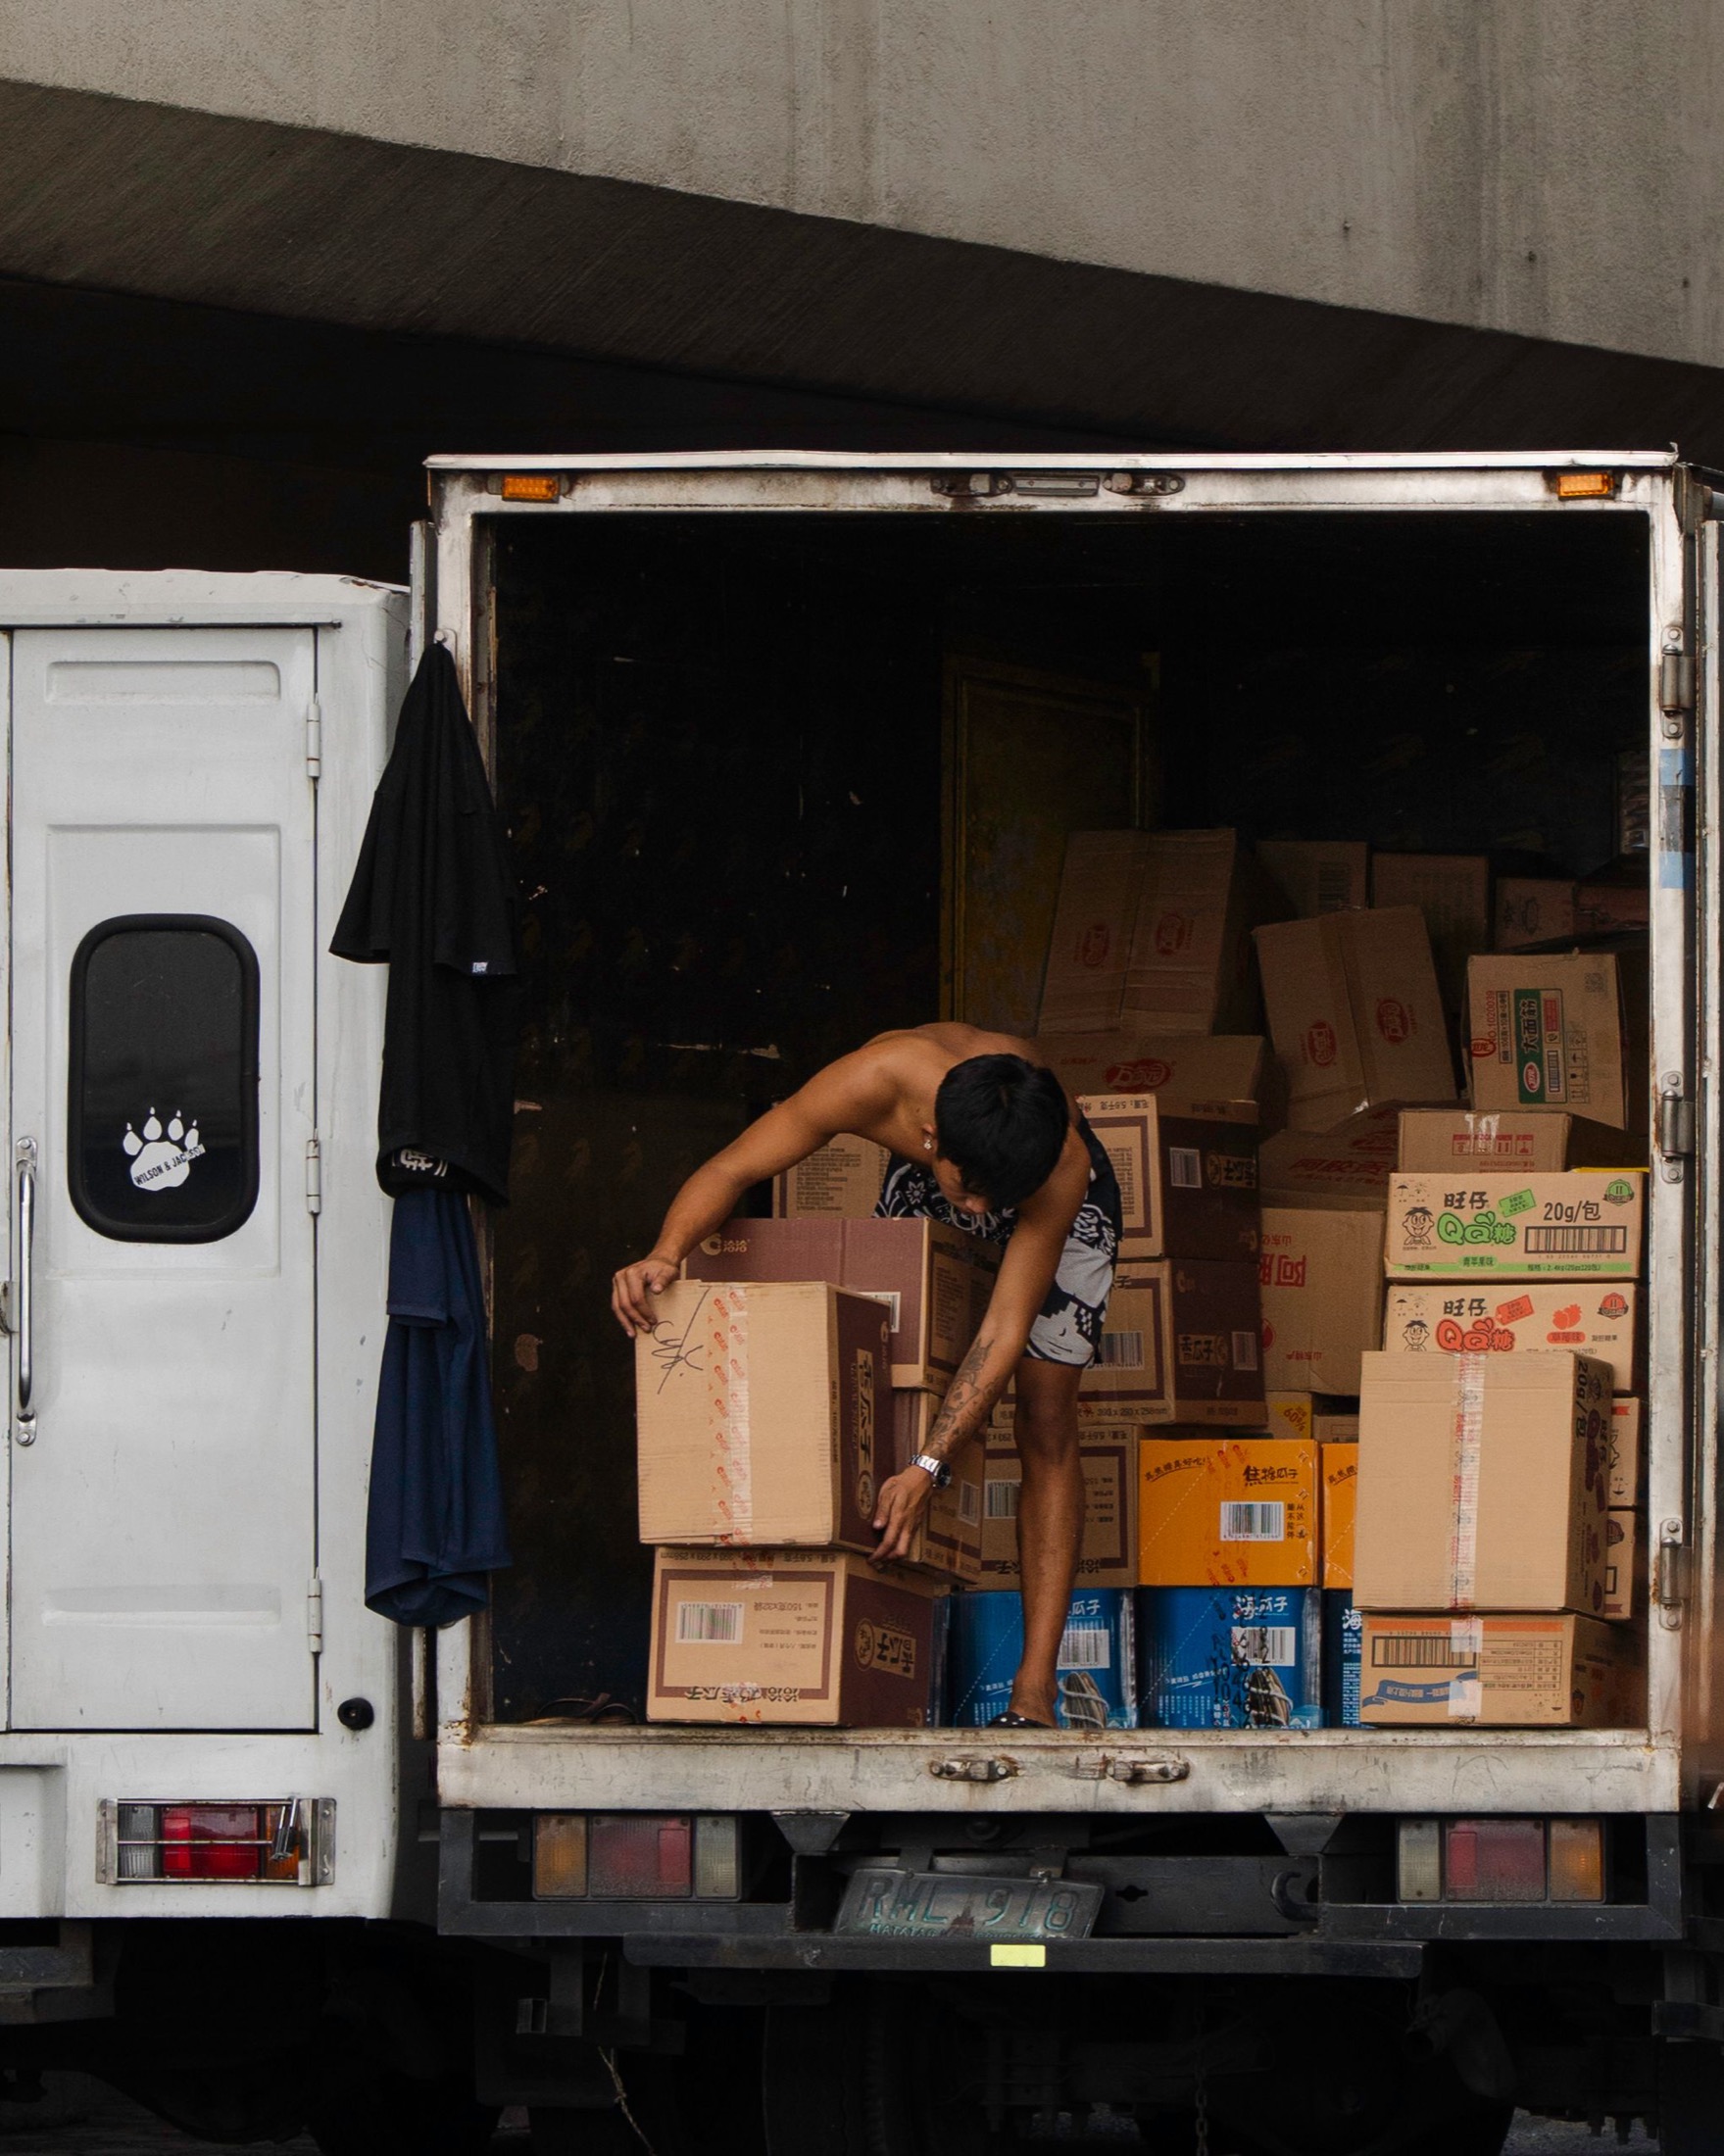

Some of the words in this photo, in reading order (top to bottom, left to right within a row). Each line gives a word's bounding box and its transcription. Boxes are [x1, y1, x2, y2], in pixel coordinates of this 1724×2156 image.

[1519, 999, 1539, 1054] 大面筋
[133, 1164, 164, 1185] WILSON
[163, 1161, 172, 1171] &
[172, 1145, 204, 1167] JACSO
[1444, 1191, 1489, 1209] 旺仔
[1544, 1200, 1601, 1223] 20g/包
[1437, 1211, 1516, 1245] QQ糖
[1443, 1298, 1487, 1316] 旺仔
[1436, 1317, 1514, 1351] QQ糖
[1576, 1360, 1588, 1438] 20g/包
[1244, 1465, 1299, 1486] 焦糖瓜子
[1068, 1598, 1101, 1615] 瓜子
[876, 1631, 915, 1679] 香瓜子
[860, 1876, 948, 1923] RML
[984, 1885, 1080, 1931] 918
